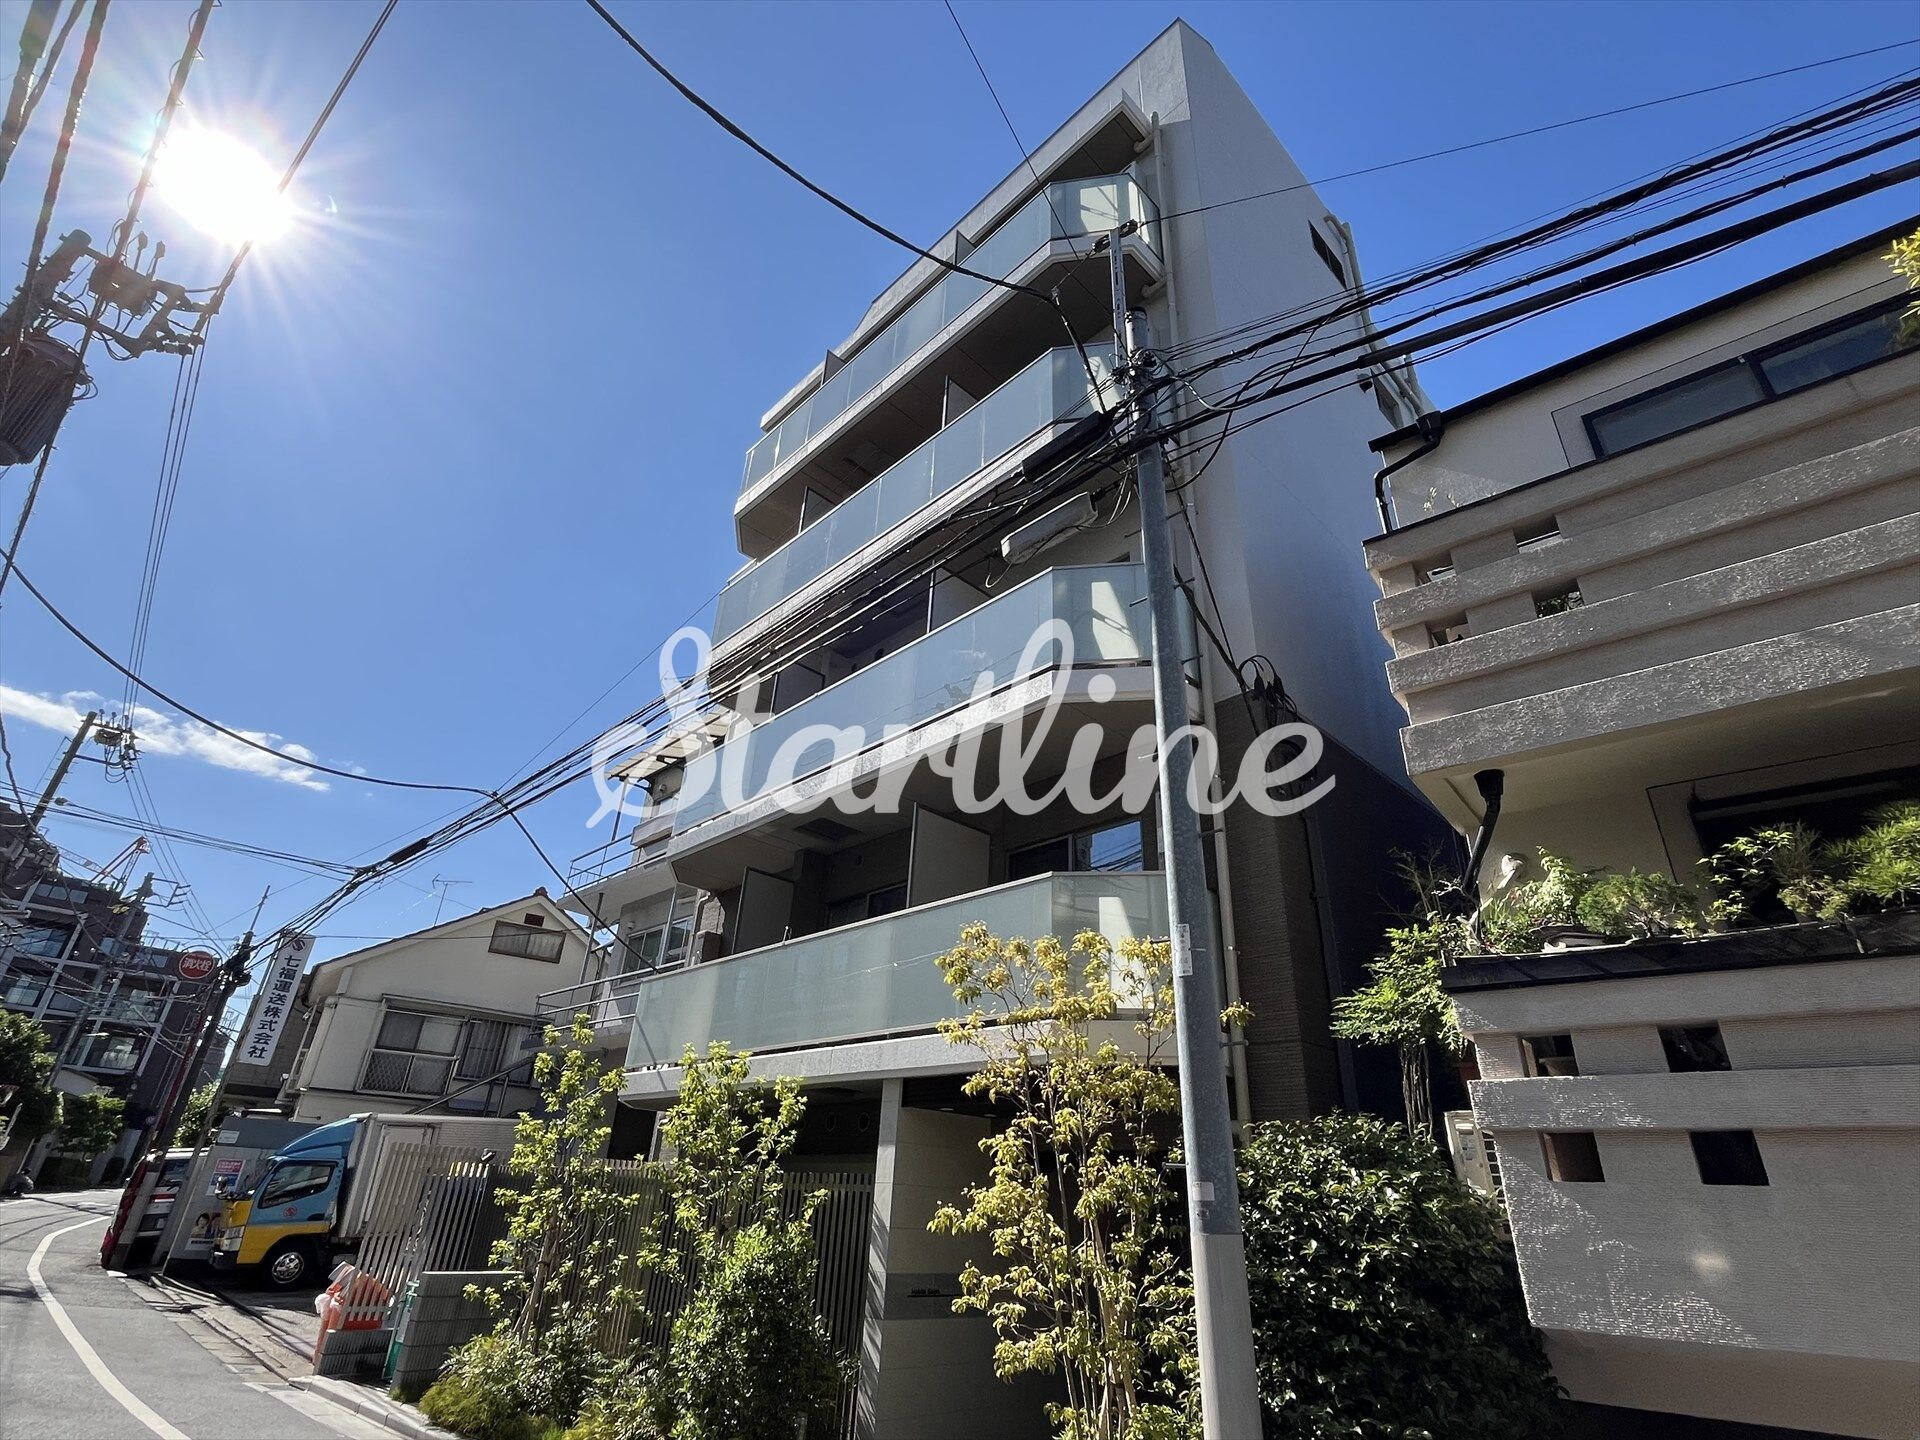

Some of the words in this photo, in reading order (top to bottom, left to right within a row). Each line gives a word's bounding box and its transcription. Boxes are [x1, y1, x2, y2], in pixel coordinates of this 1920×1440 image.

[182, 957, 212, 972] 消火栓
[247, 955, 302, 1060] 七福運送株式会社
